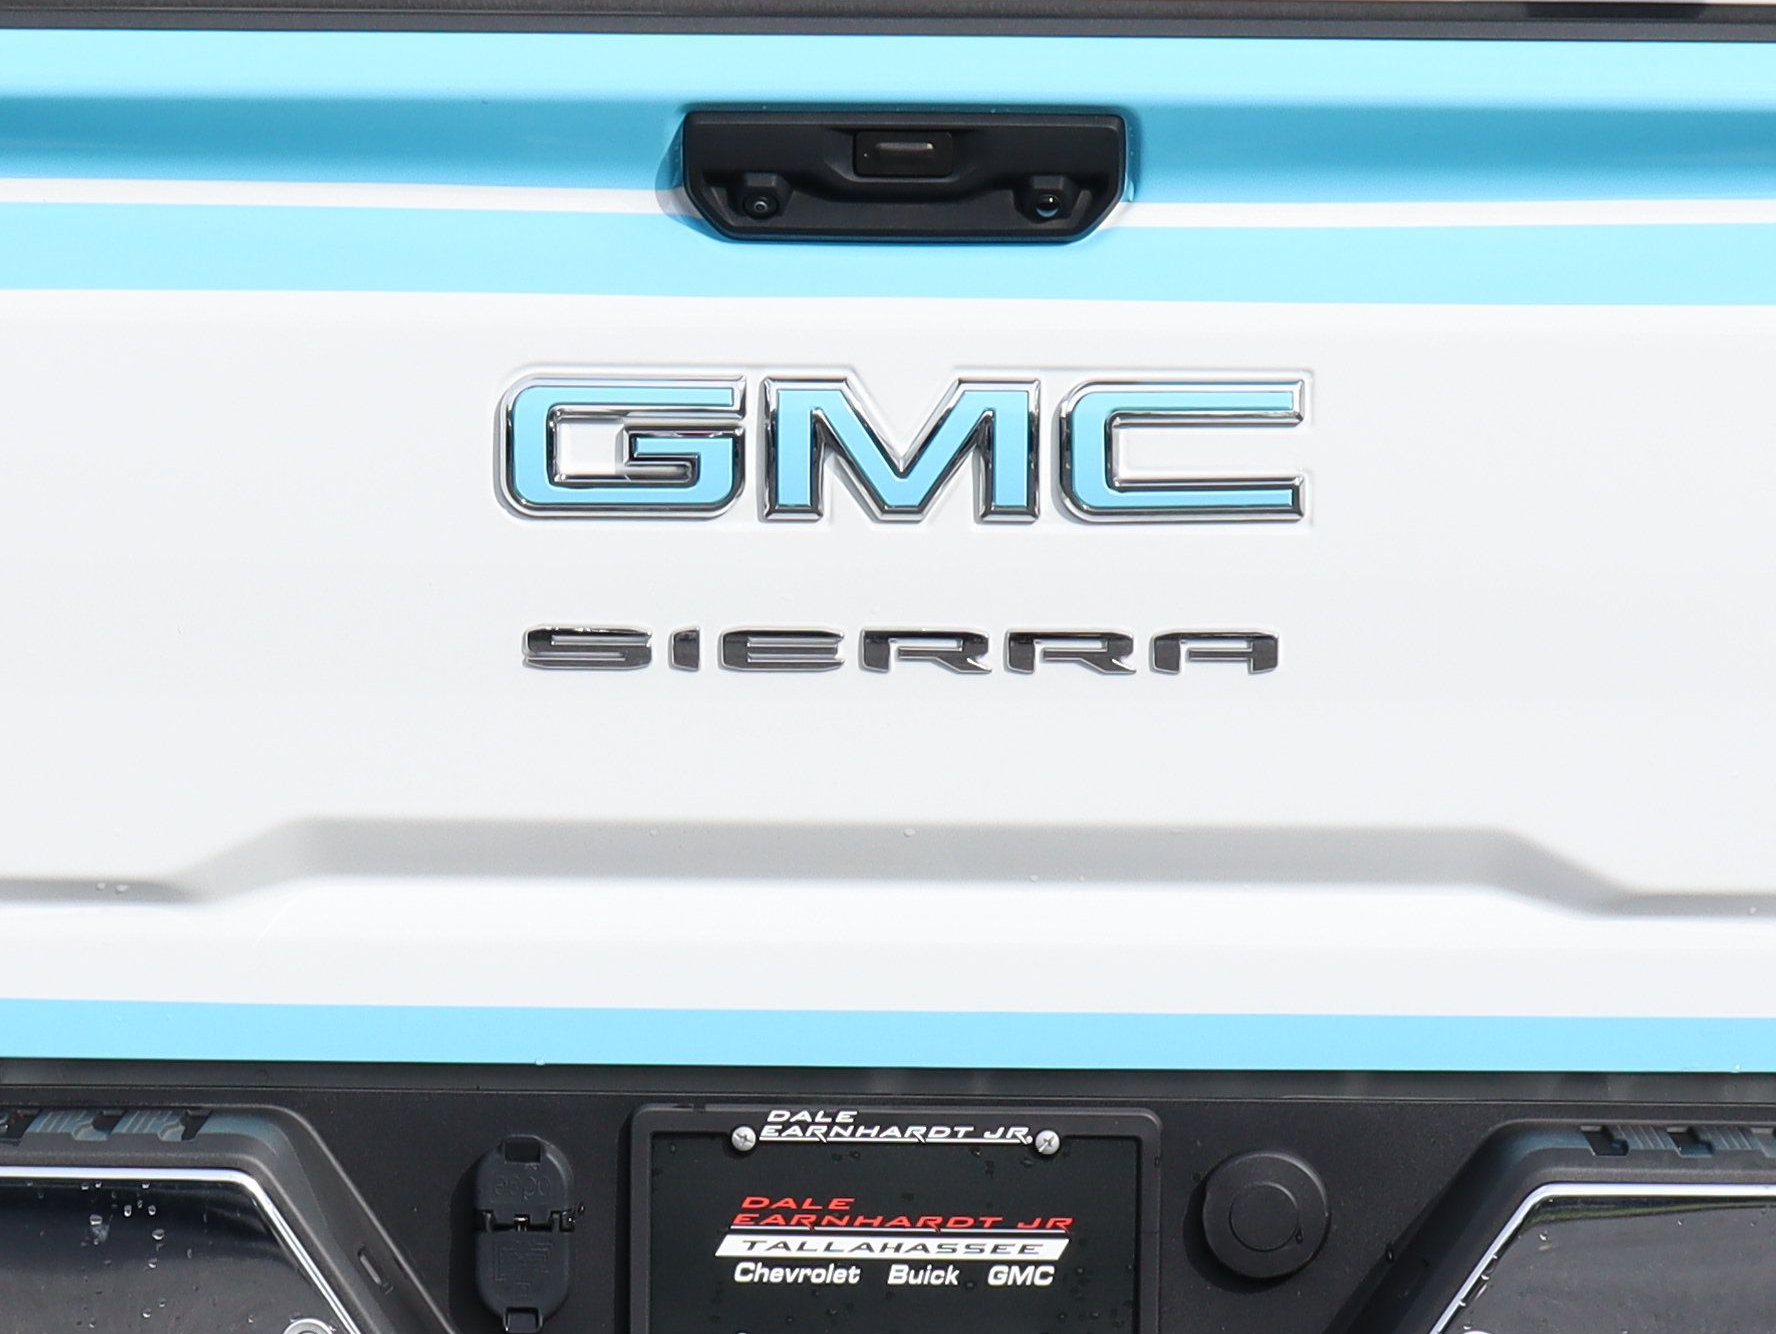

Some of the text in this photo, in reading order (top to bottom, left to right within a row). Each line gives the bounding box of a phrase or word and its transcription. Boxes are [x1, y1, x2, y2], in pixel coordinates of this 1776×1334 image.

[502, 370, 1309, 525] GMC
[522, 625, 1279, 675] SIERRA
[767, 1110, 857, 1123] DALE
[759, 1124, 974, 1143] EARNHARDT
[740, 1196, 855, 1210] DALE
[731, 1213, 1075, 1233] EARNHARDT JR
[741, 1239, 1044, 1256] TALLAHASSEE
[733, 1262, 1055, 1287] Chevrolet Buick GMC
